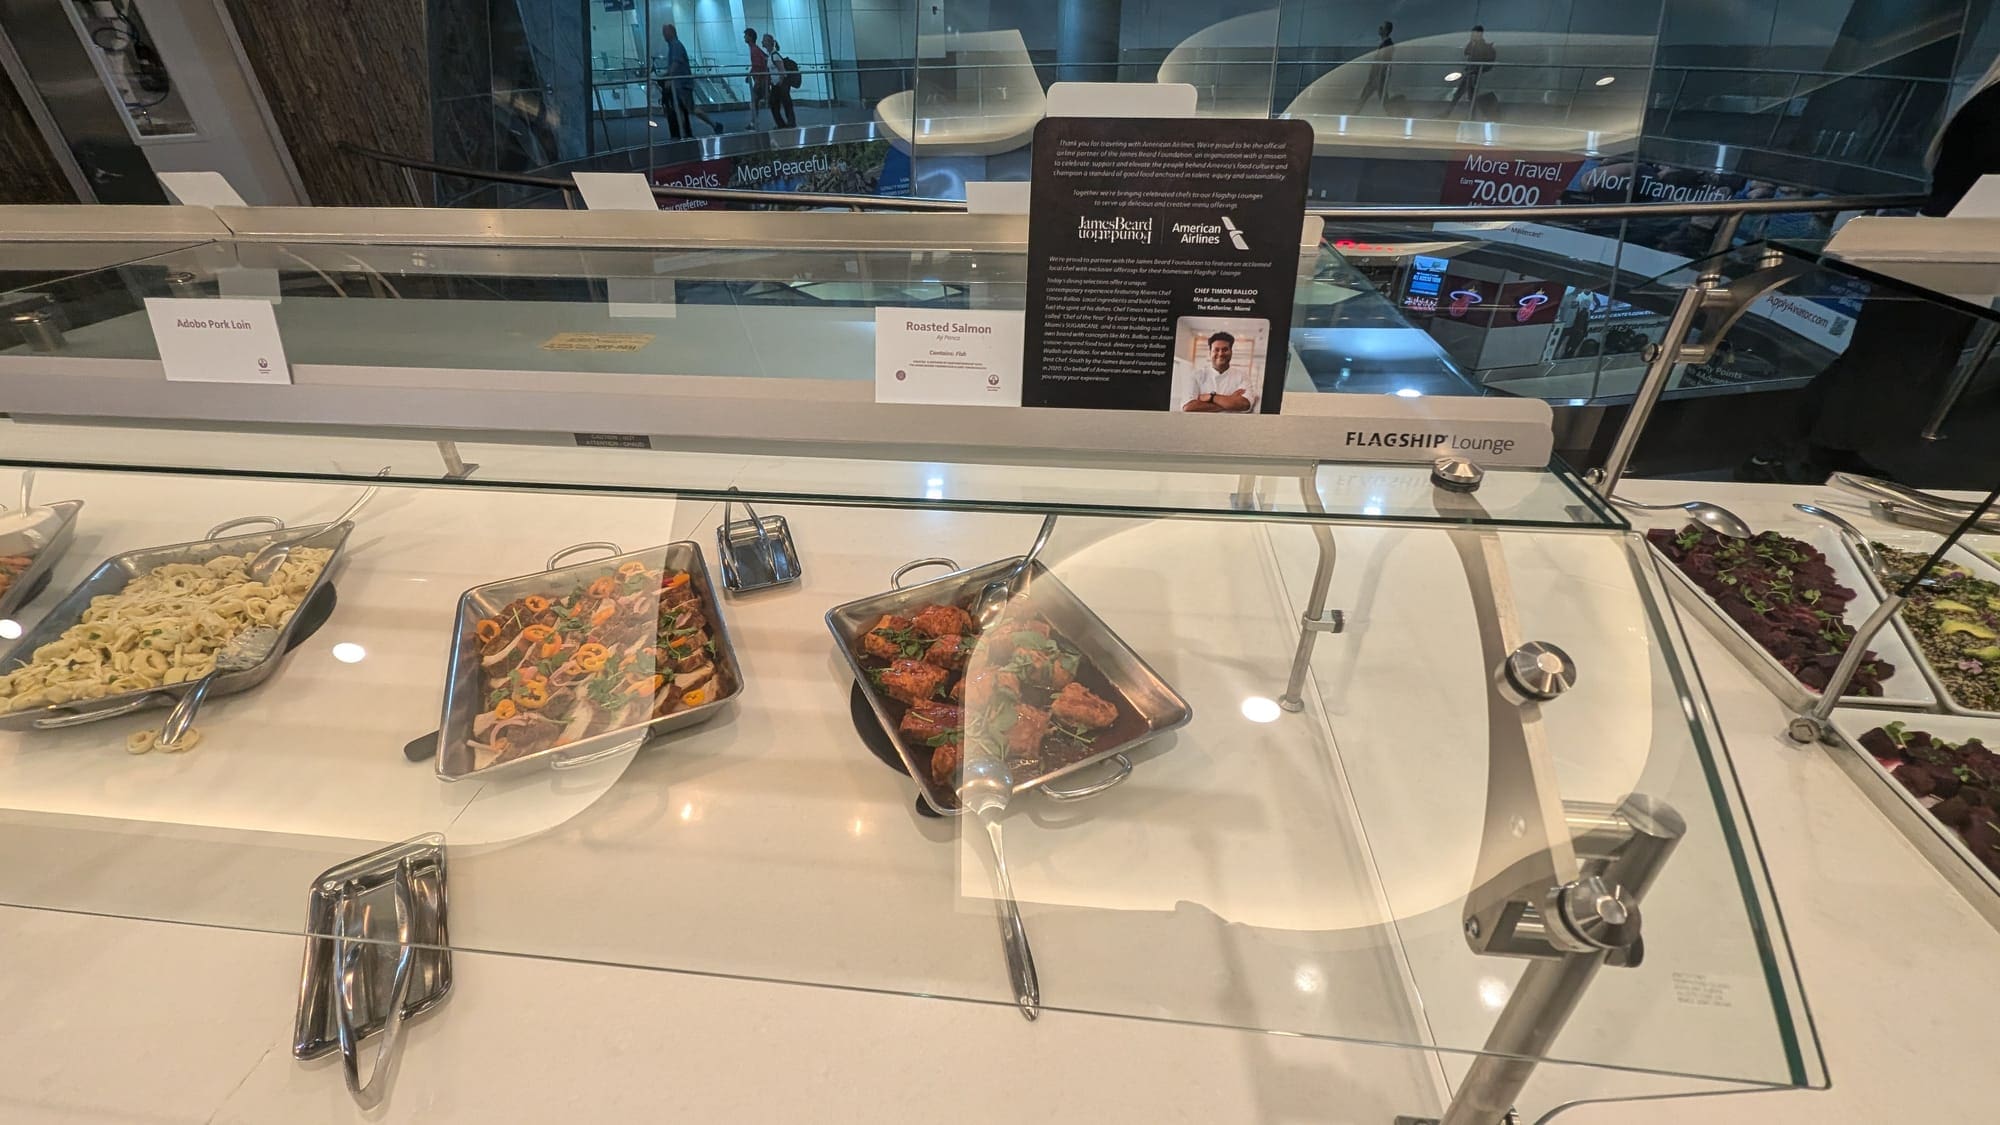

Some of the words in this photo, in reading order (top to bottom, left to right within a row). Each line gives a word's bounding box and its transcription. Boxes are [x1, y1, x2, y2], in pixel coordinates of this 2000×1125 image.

[737, 165, 772, 183] More
[774, 154, 831, 178] Peaceful.
[1054, 170, 1082, 178] champion
[1211, 172, 1231, 180] equity
[1464, 154, 1509, 175] More
[1513, 159, 1562, 182] Travel.
[684, 170, 721, 188] Perks.
[1472, 179, 1540, 206] 70,000
[1172, 222, 1221, 234] American
[1078, 229, 1152, 244] Foundation
[1181, 233, 1220, 244] Airlines
[1766, 295, 1830, 328] ApplyAviator.com
[177, 319, 207, 329] Adobo
[208, 319, 230, 329] Pork
[231, 320, 252, 330] Loin
[906, 321, 949, 332] Roasted
[952, 323, 992, 334] Salmon
[1452, 434, 1515, 455] Lounge
